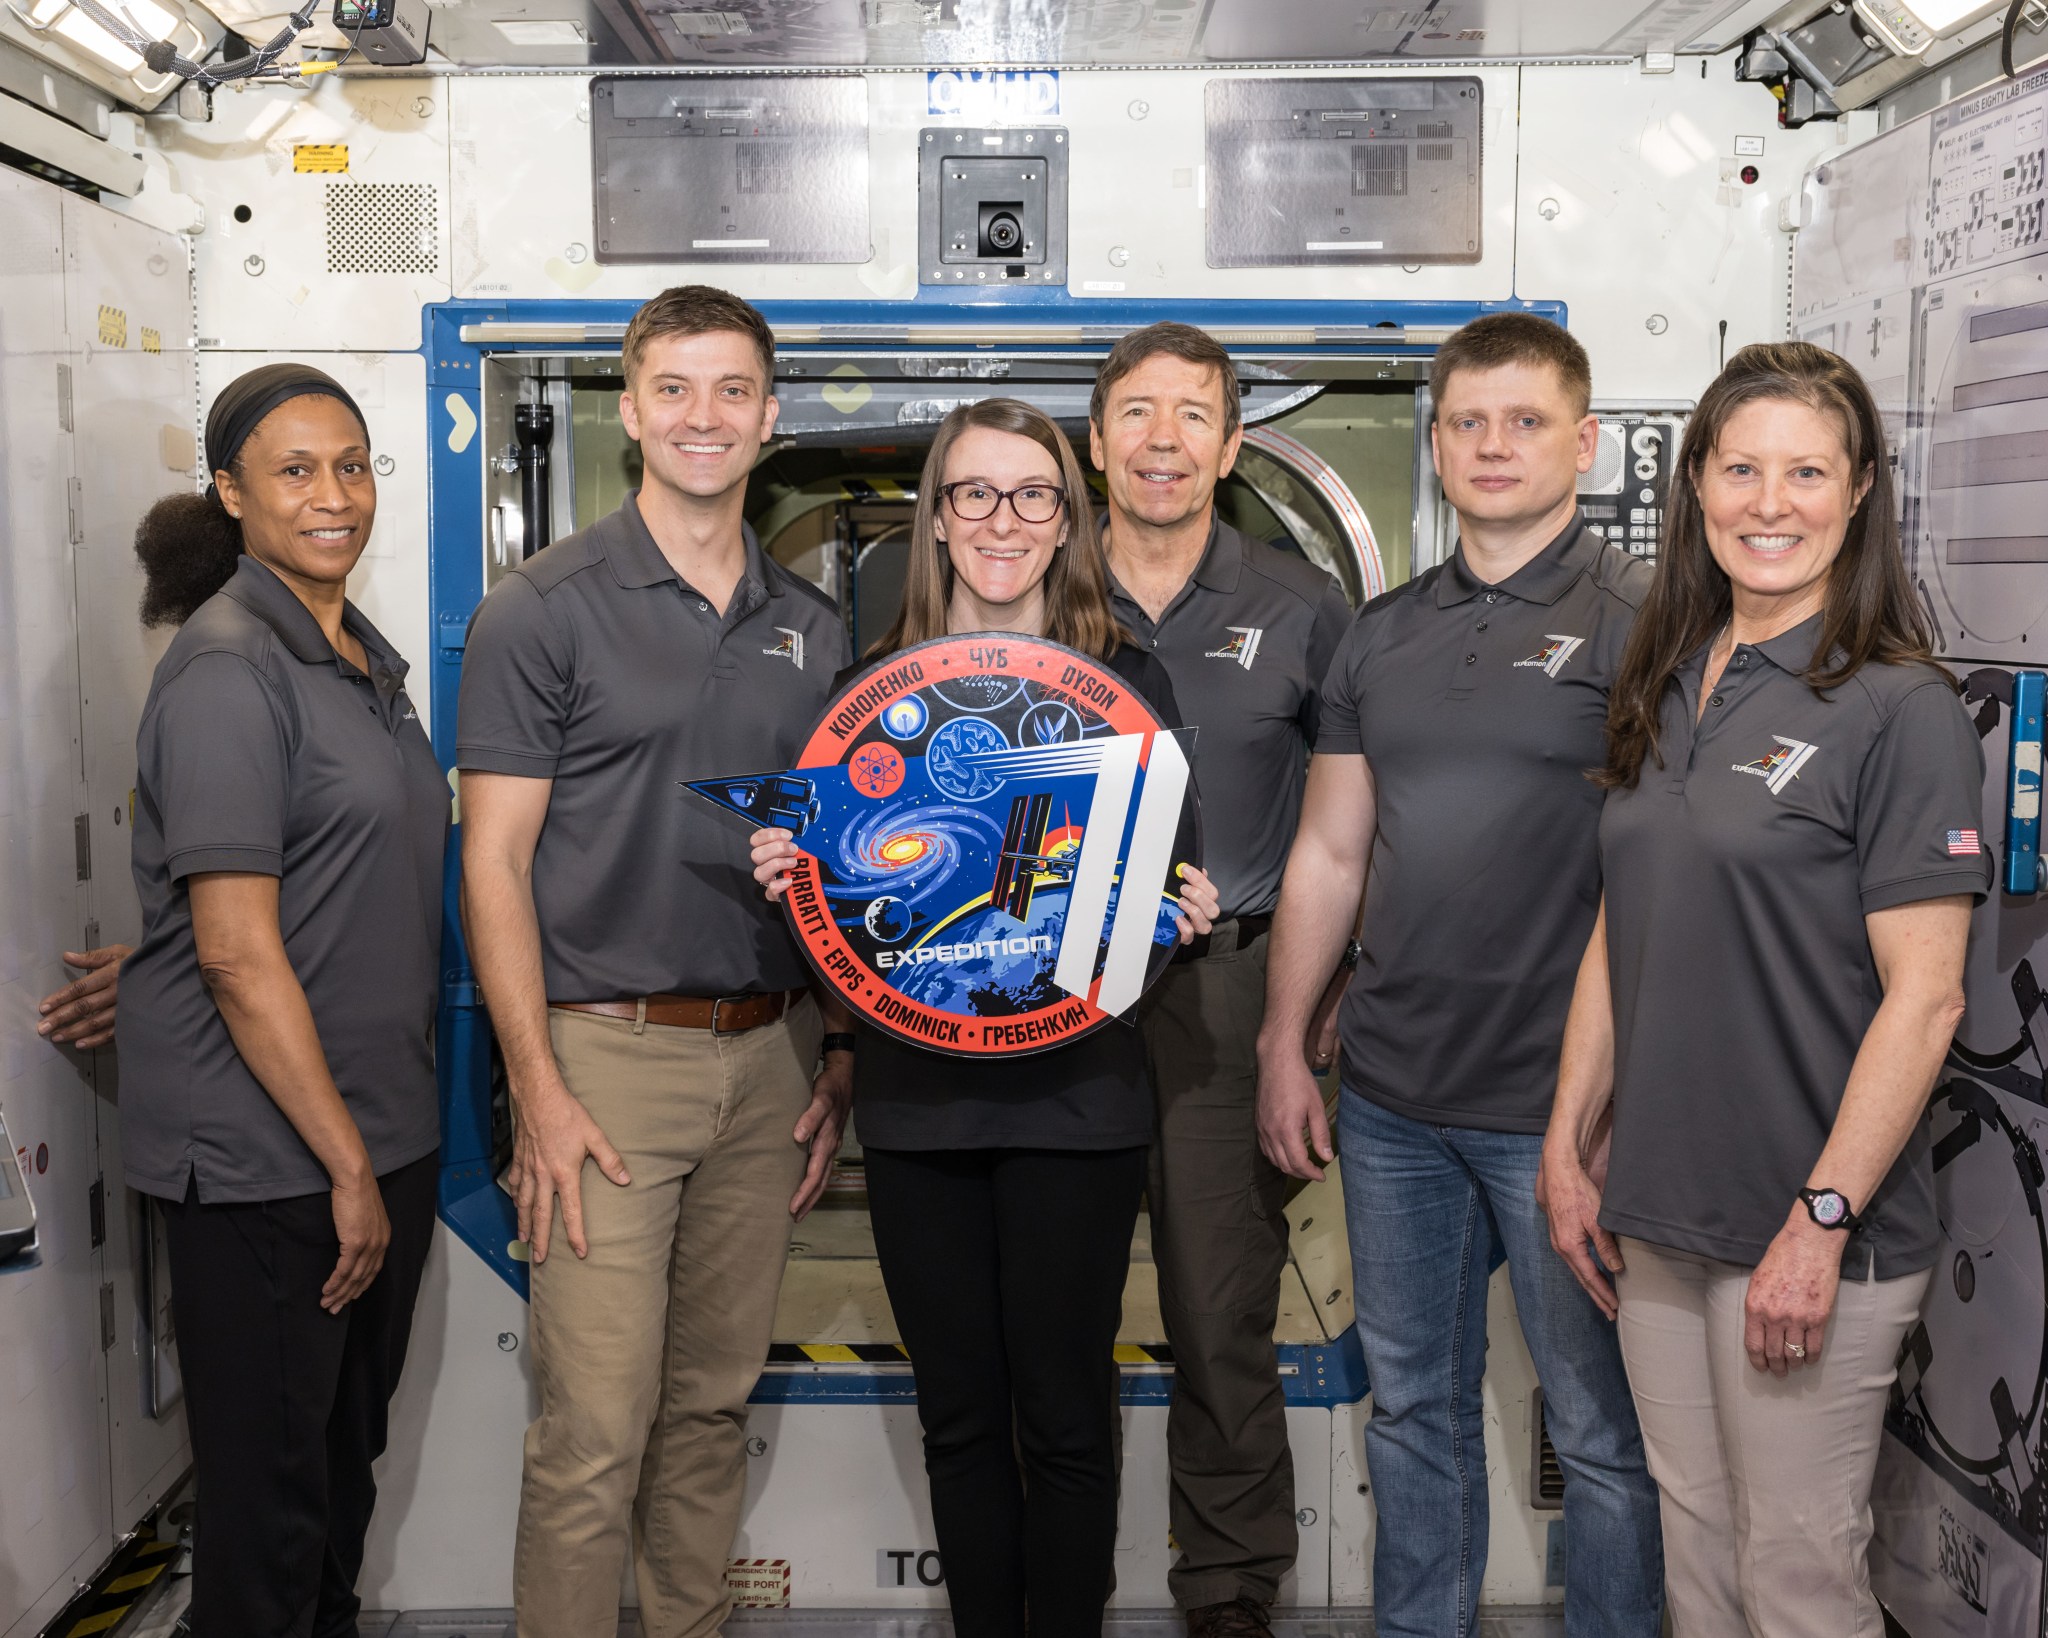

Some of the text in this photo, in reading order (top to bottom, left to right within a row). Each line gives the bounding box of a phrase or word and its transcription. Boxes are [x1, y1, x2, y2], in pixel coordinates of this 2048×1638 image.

[1960, 71, 2048, 118] MINUS EIGHTY LAB FREEZE
[968, 648, 1009, 669] ЧУБ
[828, 660, 925, 741] КОНОНЕНКО
[1060, 664, 1120, 712] DYSON
[1731, 764, 1771, 778] EXPEDITION
[790, 857, 828, 936] BARRATT
[823, 947, 866, 993] EPPS
[875, 935, 1052, 969] EXPEDITION
[873, 993, 963, 1044] DOMINICK
[983, 1002, 1090, 1047] ГРЕБЕНКИН
[728, 1580, 781, 1589] FIRE PORT
